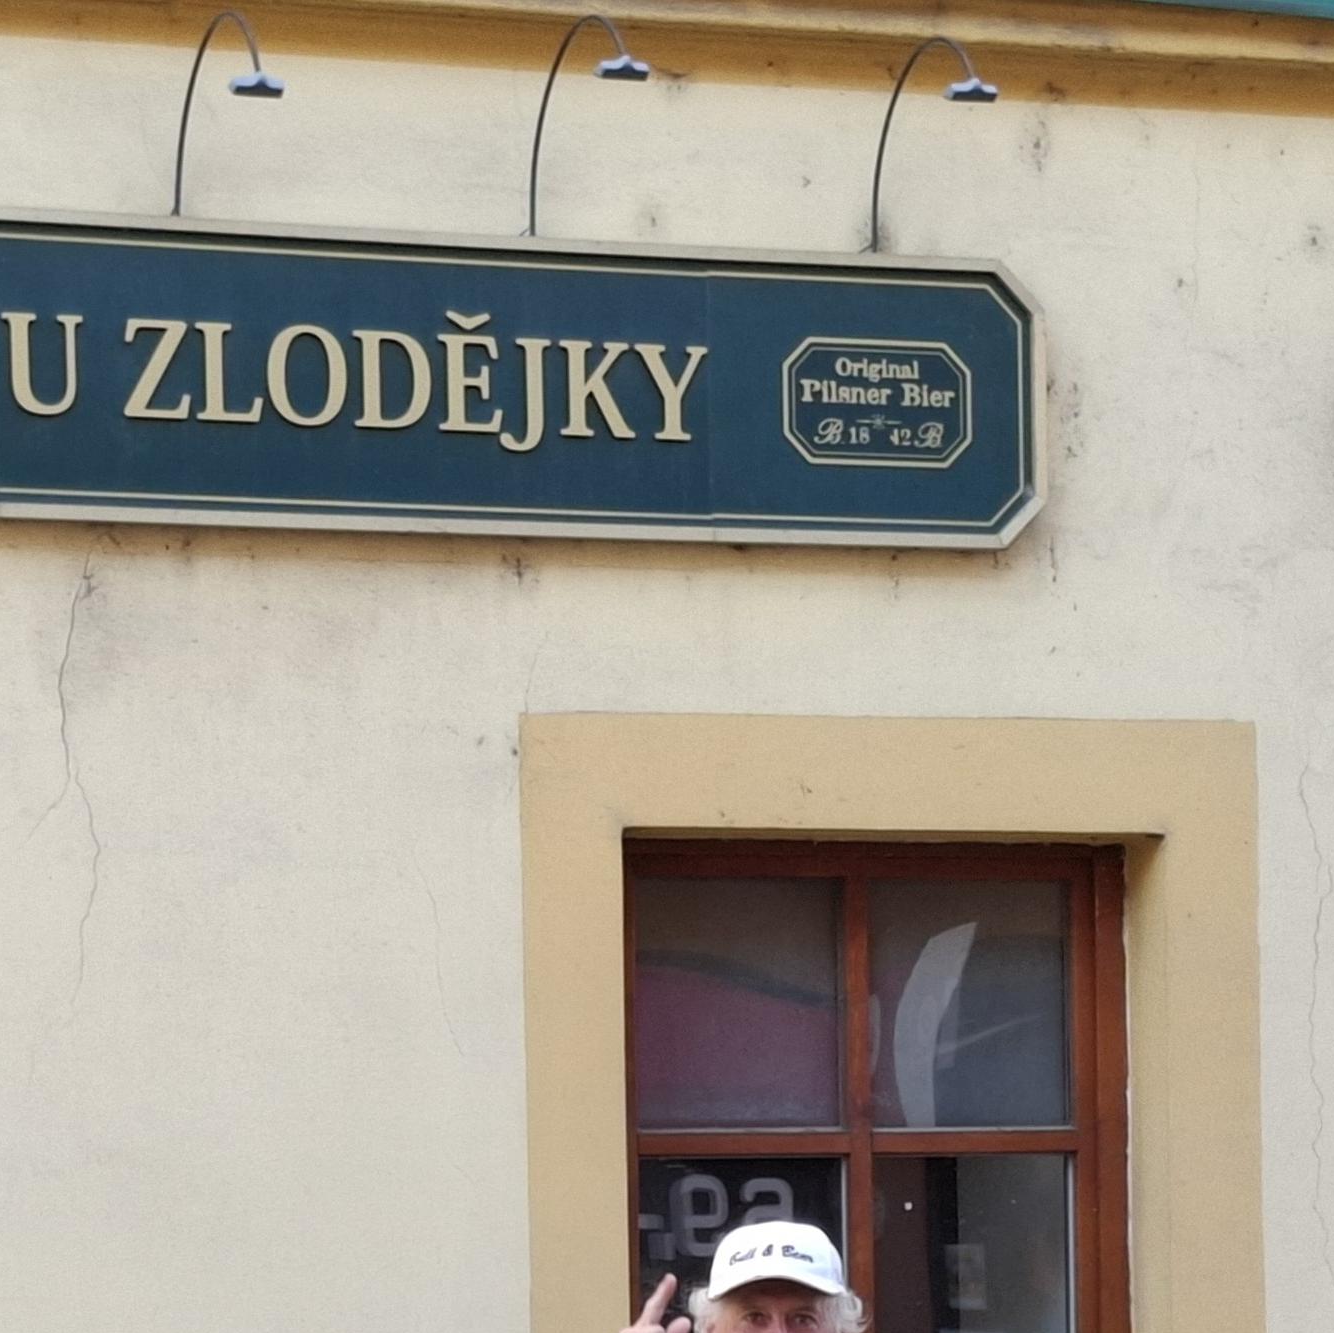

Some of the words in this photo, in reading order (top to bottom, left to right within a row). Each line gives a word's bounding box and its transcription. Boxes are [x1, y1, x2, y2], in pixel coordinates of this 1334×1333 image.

[0, 311, 84, 416] U
[121, 308, 708, 453] ZLODĚJKY
[834, 357, 920, 383] Original
[799, 379, 893, 406] Pilsner
[900, 383, 956, 408] Bier
